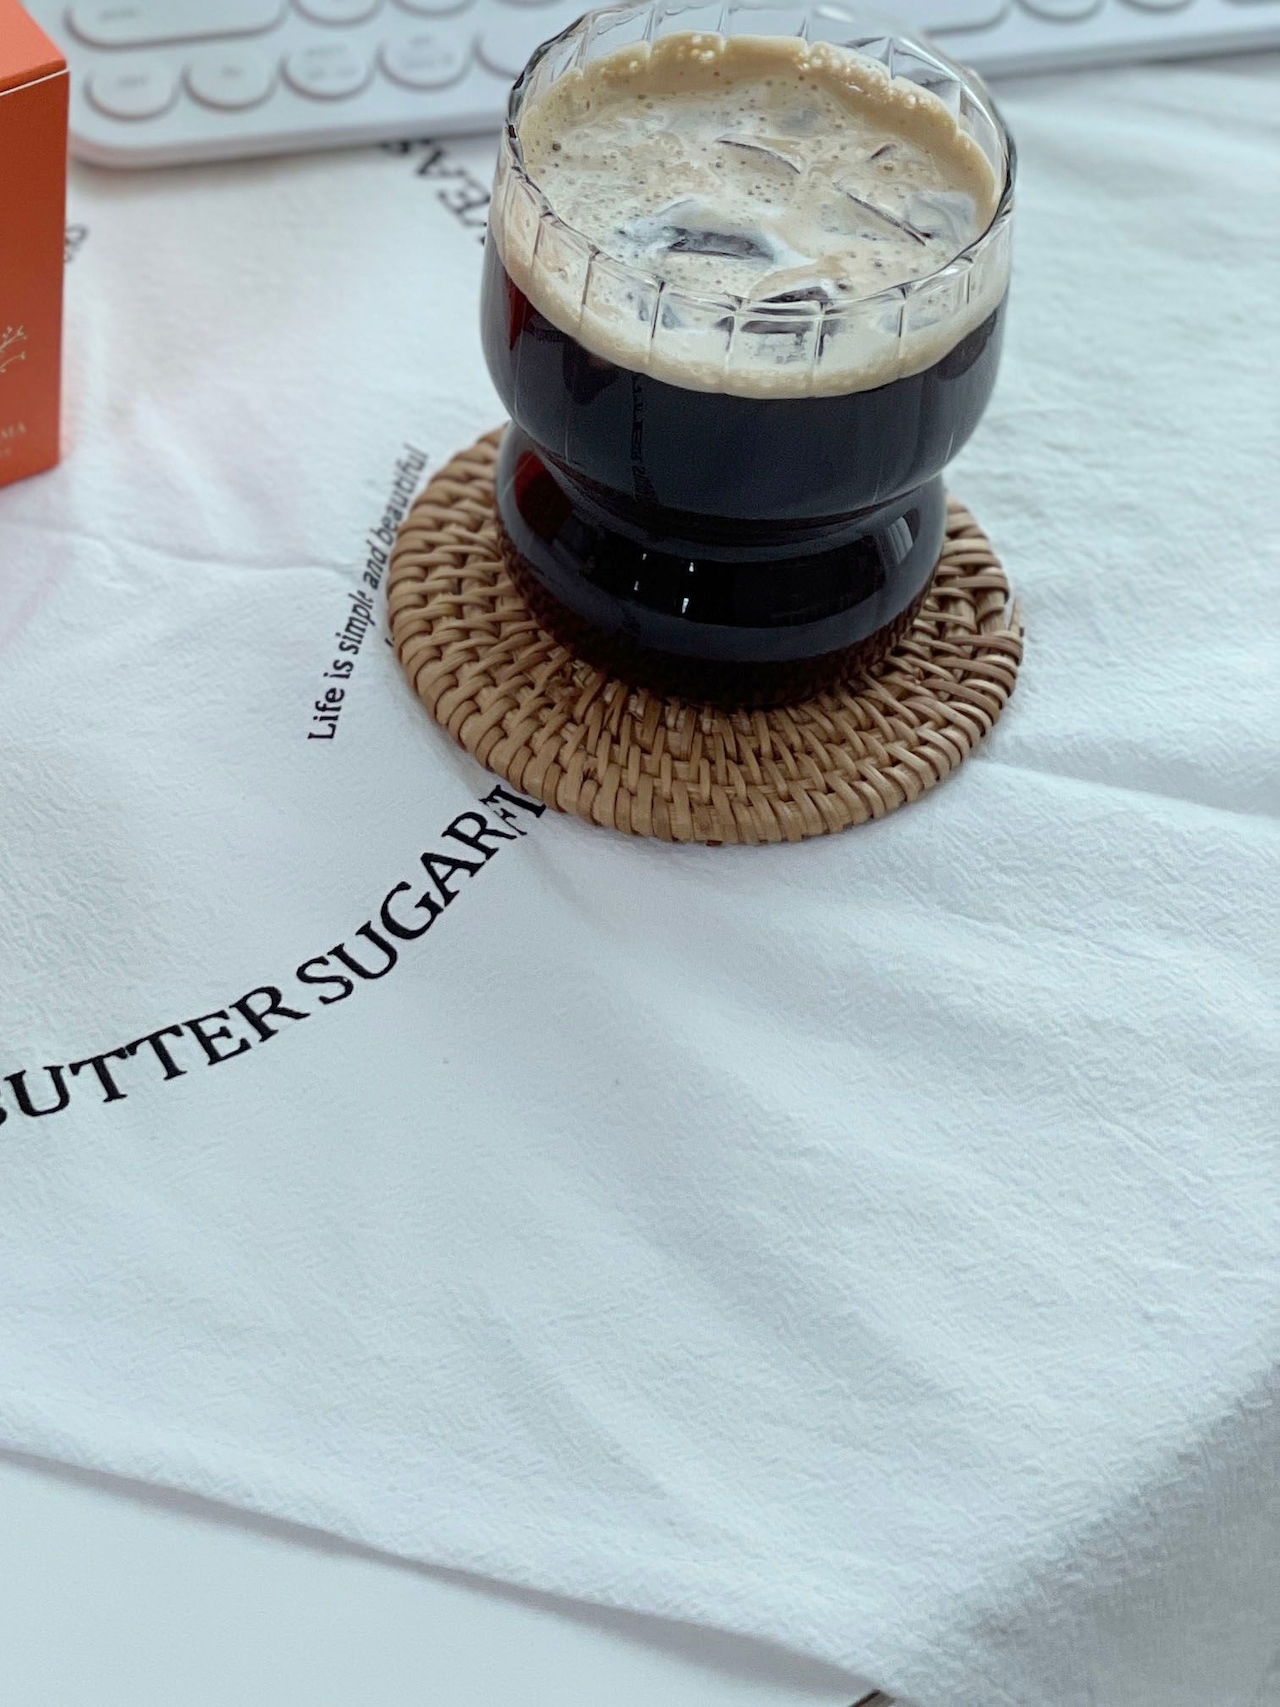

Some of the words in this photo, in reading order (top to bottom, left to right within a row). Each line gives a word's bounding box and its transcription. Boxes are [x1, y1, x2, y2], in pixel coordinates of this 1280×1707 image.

[375, 442, 430, 548] beautiful
[362, 530, 389, 591] and
[323, 658, 354, 681] is
[307, 686, 345, 741] Life
[296, 811, 518, 1005] SUGAR
